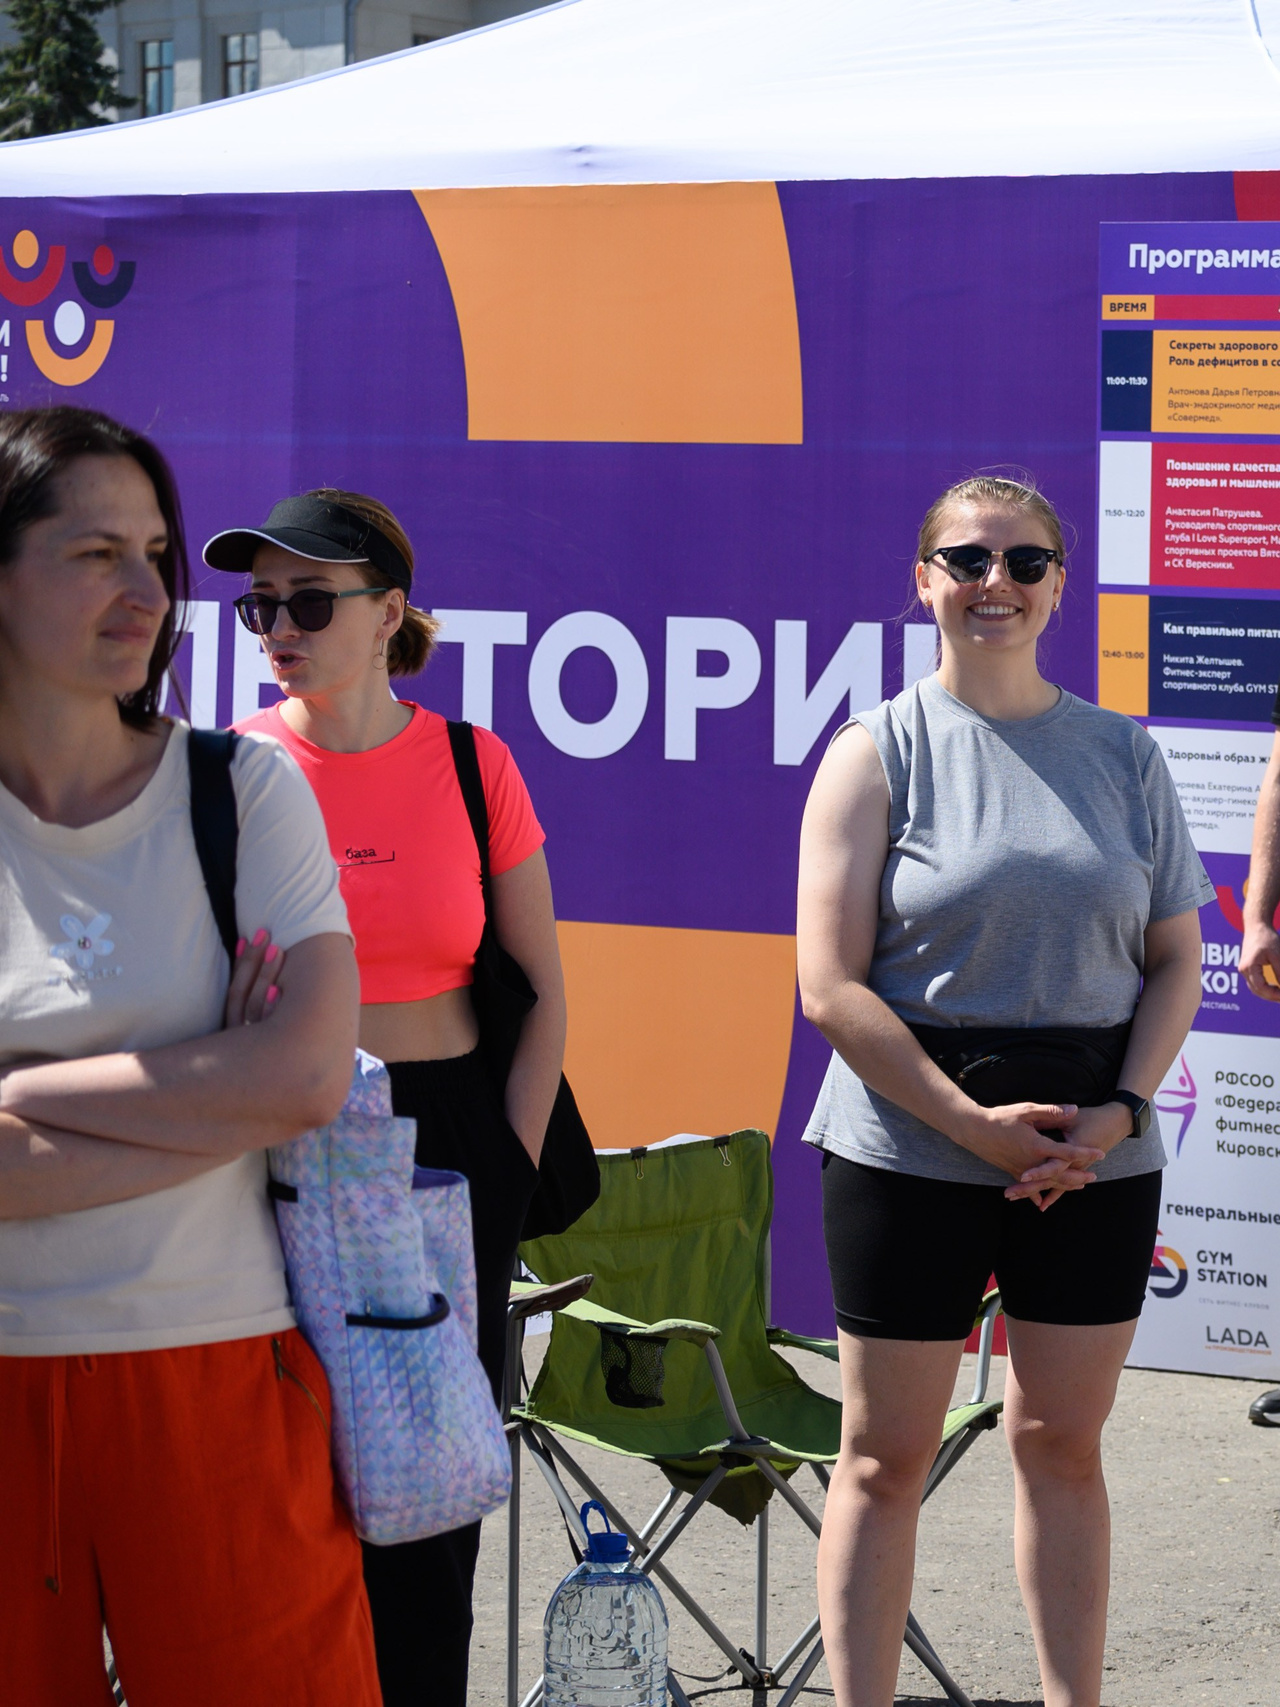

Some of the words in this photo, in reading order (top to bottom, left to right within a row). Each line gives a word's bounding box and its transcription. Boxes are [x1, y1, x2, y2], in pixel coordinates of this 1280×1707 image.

[1109, 302, 1147, 313] ВРЕМЯ
[1169, 340, 1216, 352] Секреты
[1219, 342, 1278, 353] здорового
[1168, 356, 1195, 366] Роль
[1197, 357, 1259, 368] дефицитов
[1261, 359, 1268, 367] в
[1106, 376, 1148, 386] 11:00-11:30
[1168, 387, 1210, 396] Антонова
[1212, 387, 1240, 397] Дарья
[1168, 400, 1255, 410] Врач-эндокринолог
[1167, 413, 1222, 422] «Совермед».
[1166, 459, 1231, 472] Повышение
[1166, 477, 1217, 489] здоровья
[1219, 479, 1228, 488] и
[1105, 509, 1145, 518] 11:50-12:20
[1165, 506, 1211, 517] Анастасия
[1212, 507, 1263, 519] Патрушева.
[1165, 519, 1226, 531] Руководитель
[1164, 532, 1190, 544] клуба
[1197, 534, 1217, 543] Love
[1218, 535, 1269, 546] Supersport,
[1164, 546, 1216, 557] спортивных
[1217, 548, 1259, 558] проектов
[1164, 560, 1171, 568] и
[1172, 559, 1184, 568] СК
[1185, 559, 1235, 570] Вересники.
[1163, 622, 1184, 634] Как
[1186, 625, 1246, 637] правильно
[1163, 654, 1195, 664] Никита
[1196, 655, 1245, 667] Желтышев.
[1163, 666, 1232, 680] Фитнес-эксперт
[1163, 681, 1217, 691] спортивного
[1218, 683, 1245, 694] клуба
[1246, 683, 1267, 693] GYM
[1167, 749, 1222, 762] Здоровый
[1224, 752, 1256, 765] образ
[1207, 782, 1252, 793] Екатерина
[1206, 810, 1247, 819] хирургии
[345, 847, 377, 860] база
[1215, 1071, 1275, 1088] РФСОО
[1197, 1250, 1233, 1266] GYM
[1197, 1268, 1268, 1288] STATION
[1206, 1325, 1270, 1349] LADA
